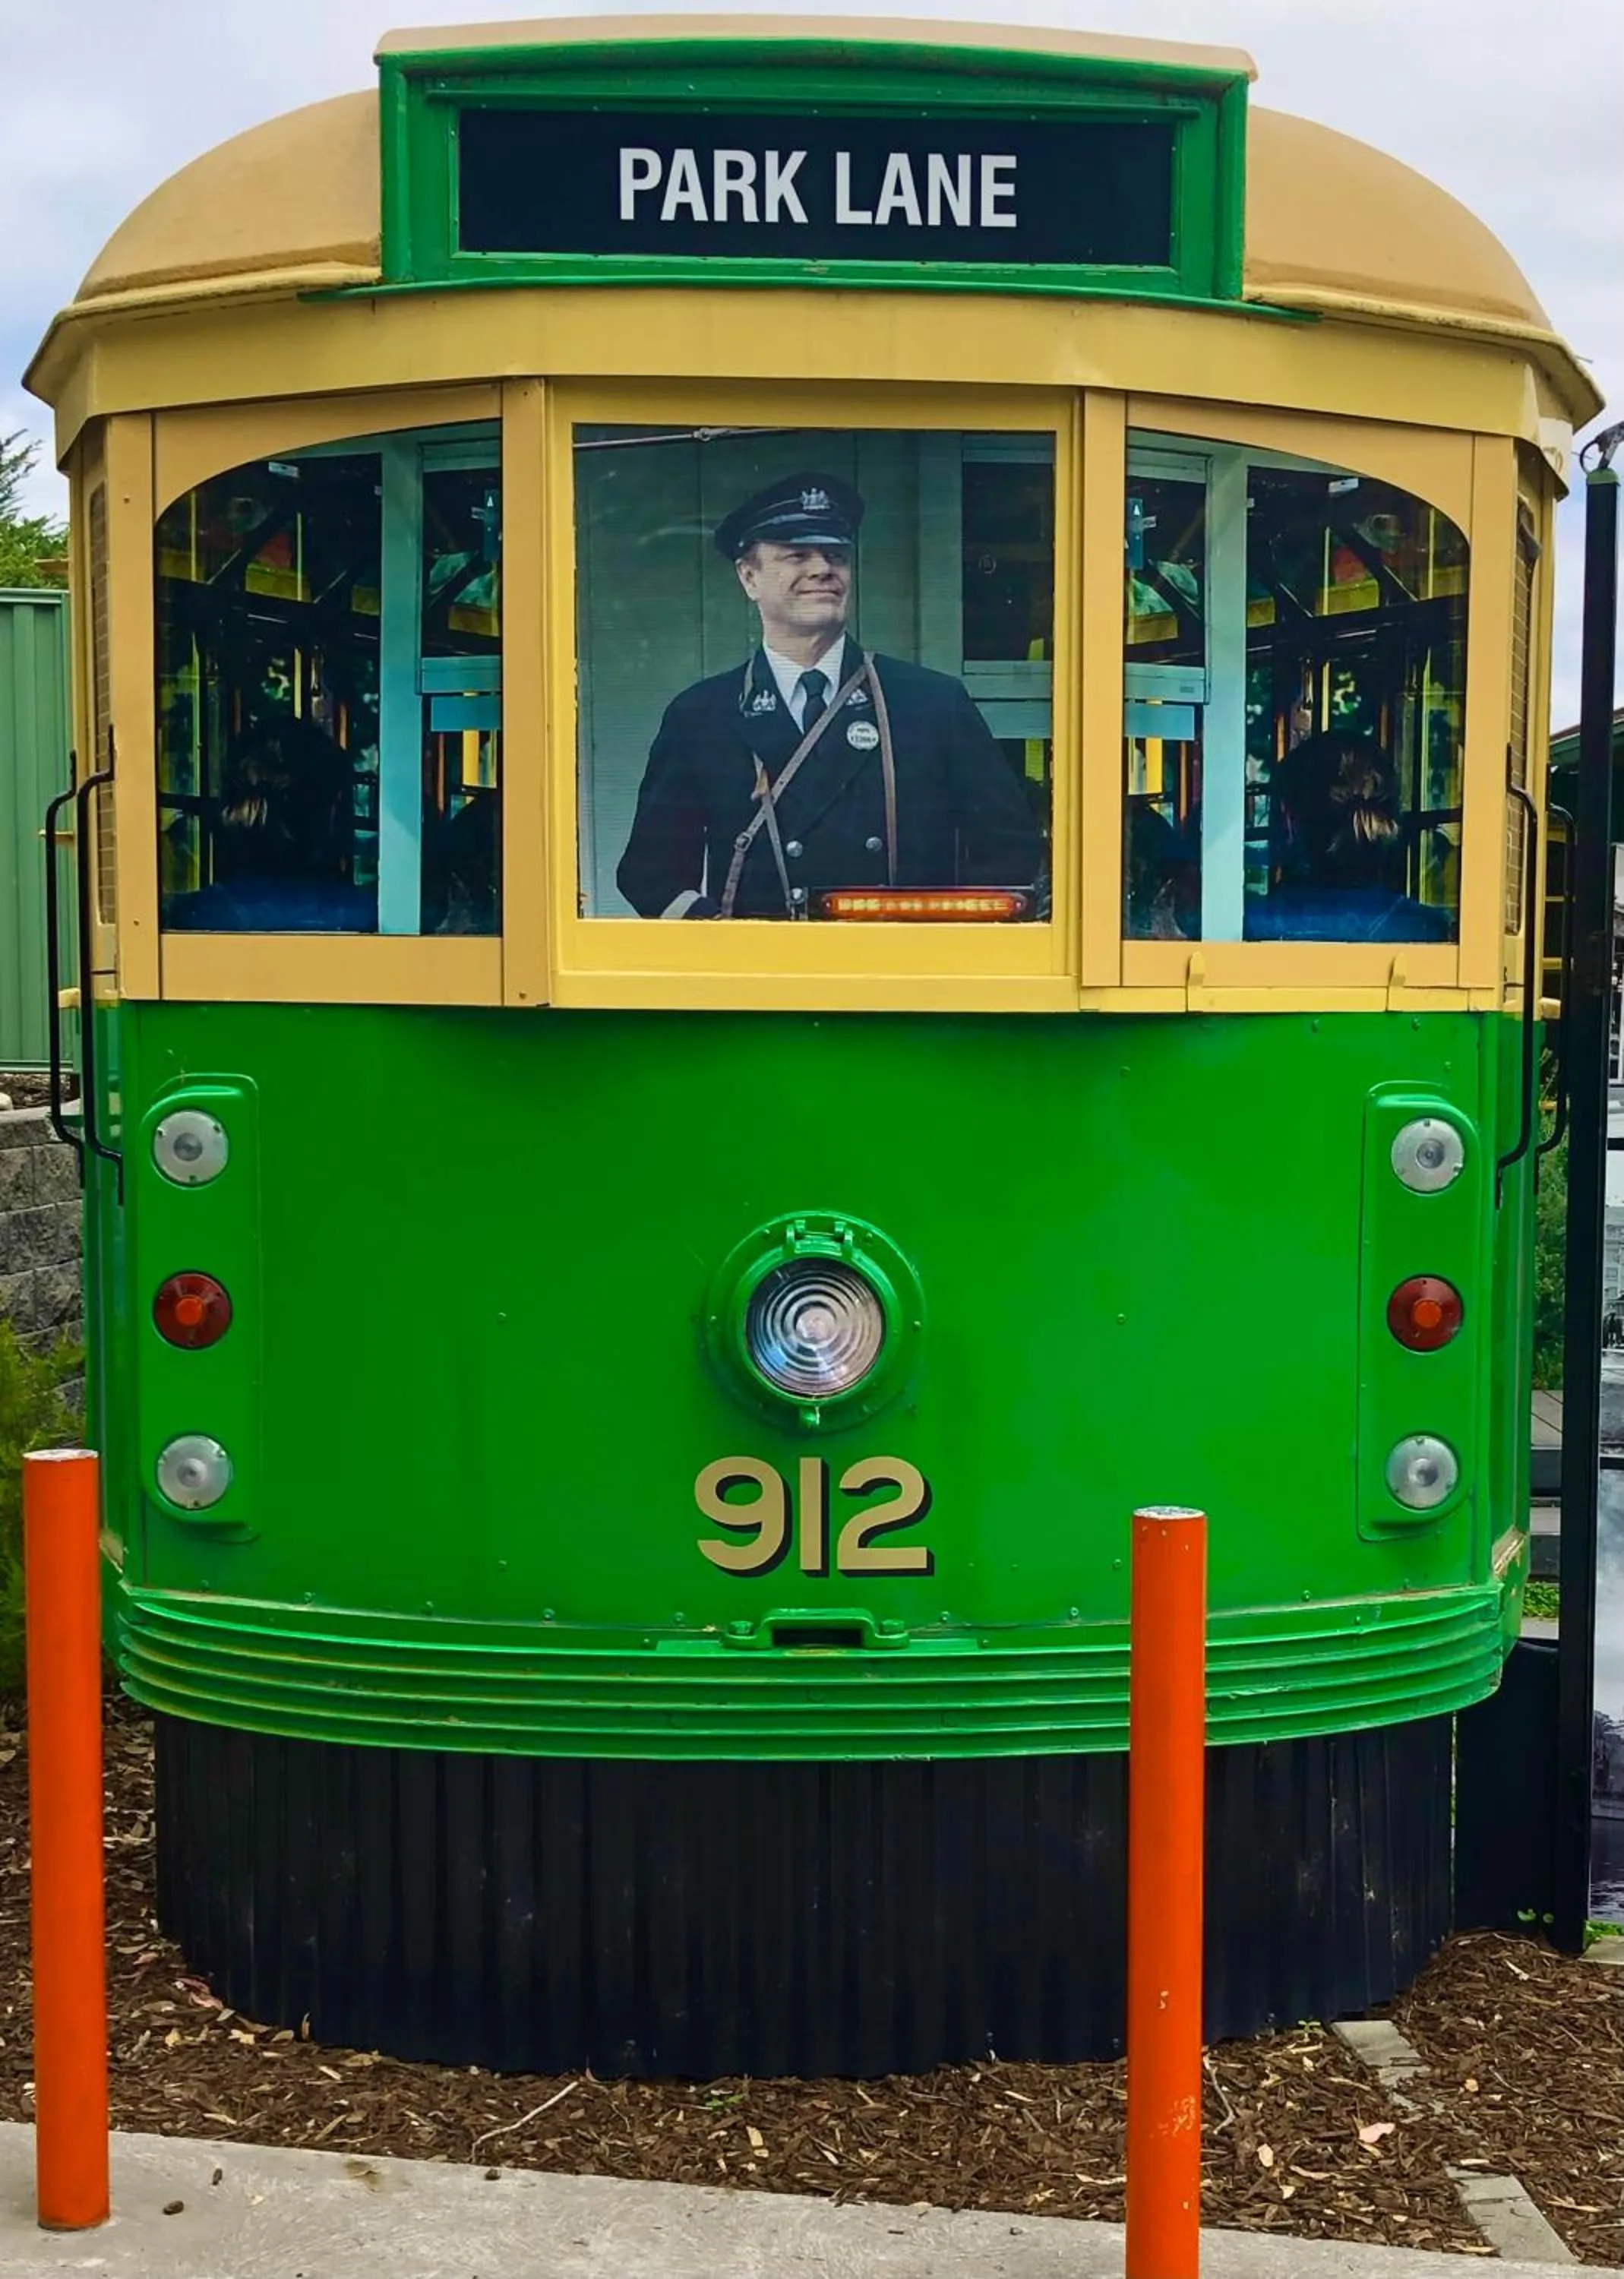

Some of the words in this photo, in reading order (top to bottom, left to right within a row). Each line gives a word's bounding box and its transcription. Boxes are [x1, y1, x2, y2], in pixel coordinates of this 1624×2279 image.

[619, 147, 809, 223] PARK
[836, 151, 1017, 228] LANE
[694, 1456, 934, 1578] 912
